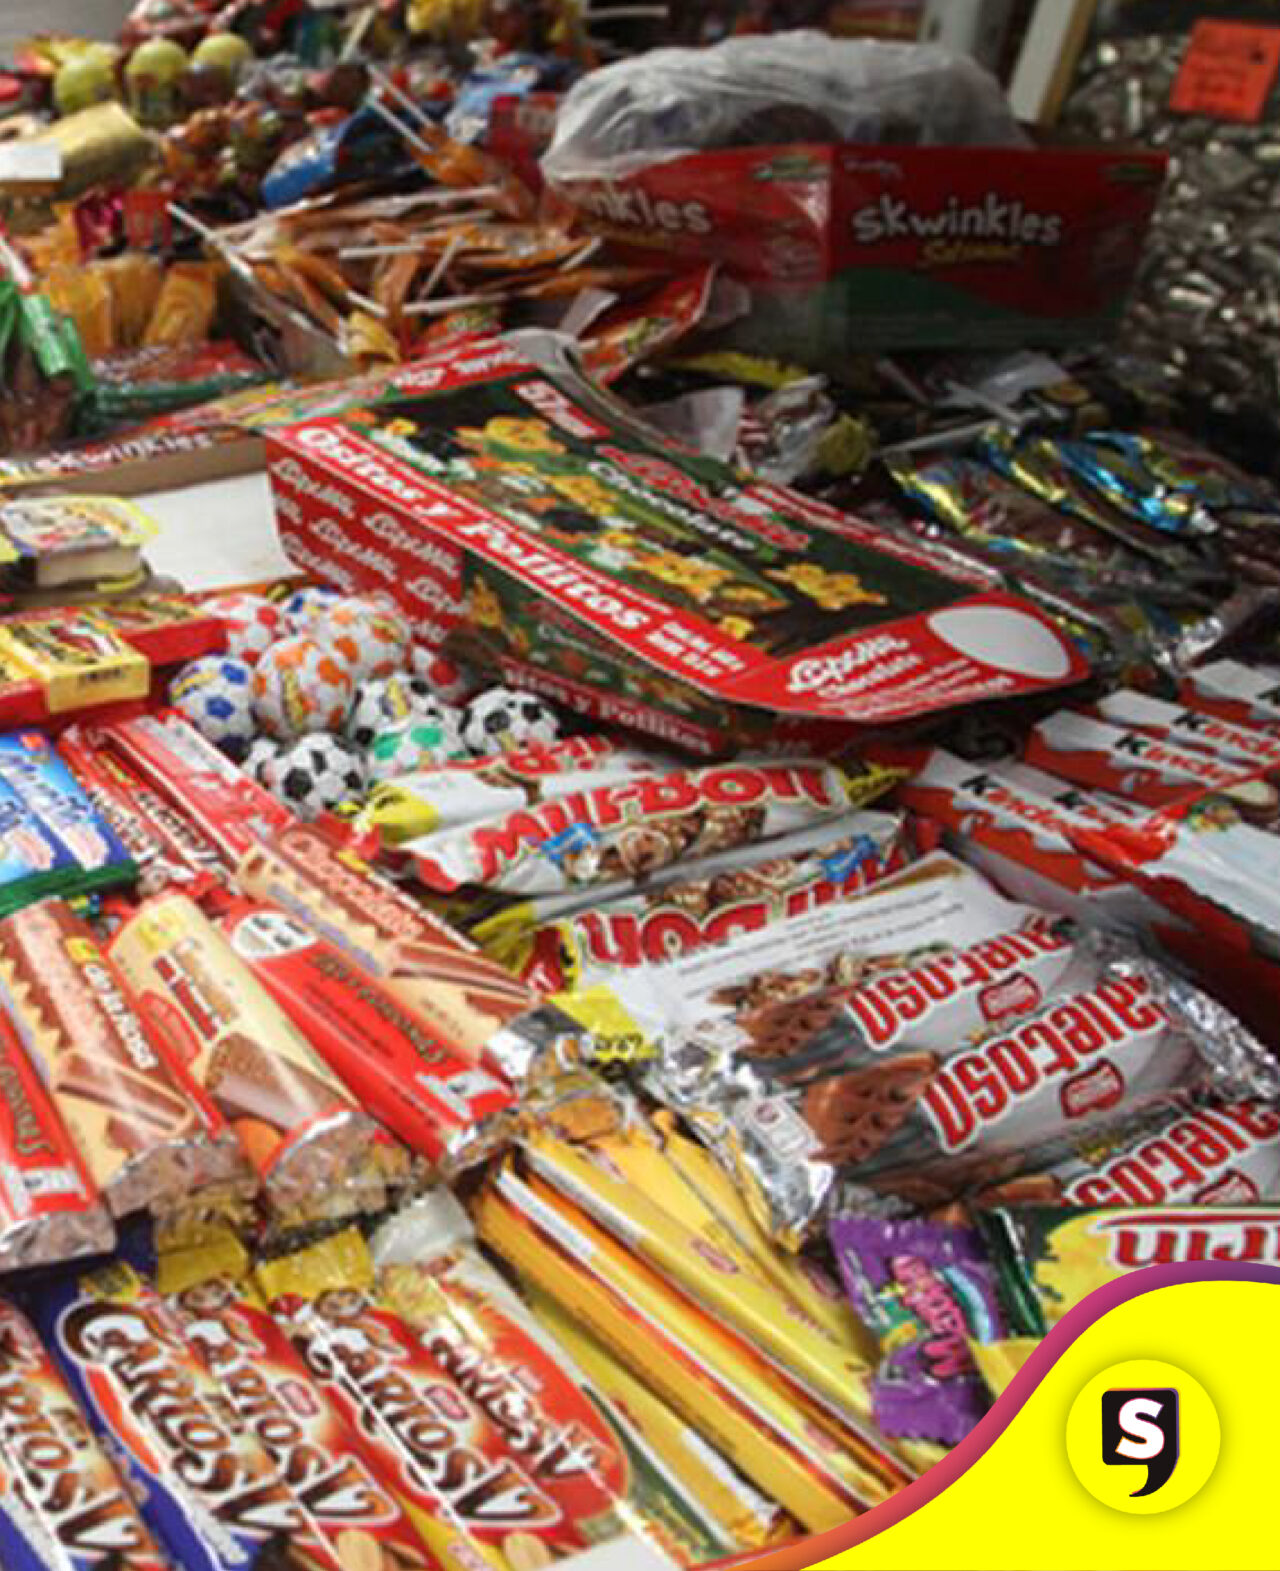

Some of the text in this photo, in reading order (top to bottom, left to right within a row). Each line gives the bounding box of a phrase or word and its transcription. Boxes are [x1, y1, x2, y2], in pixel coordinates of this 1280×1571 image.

[458, 510, 651, 633] Pollitos
[57, 1300, 277, 1494] CARLOS
[286, 1460, 400, 1528] V
[440, 1454, 564, 1530] V
